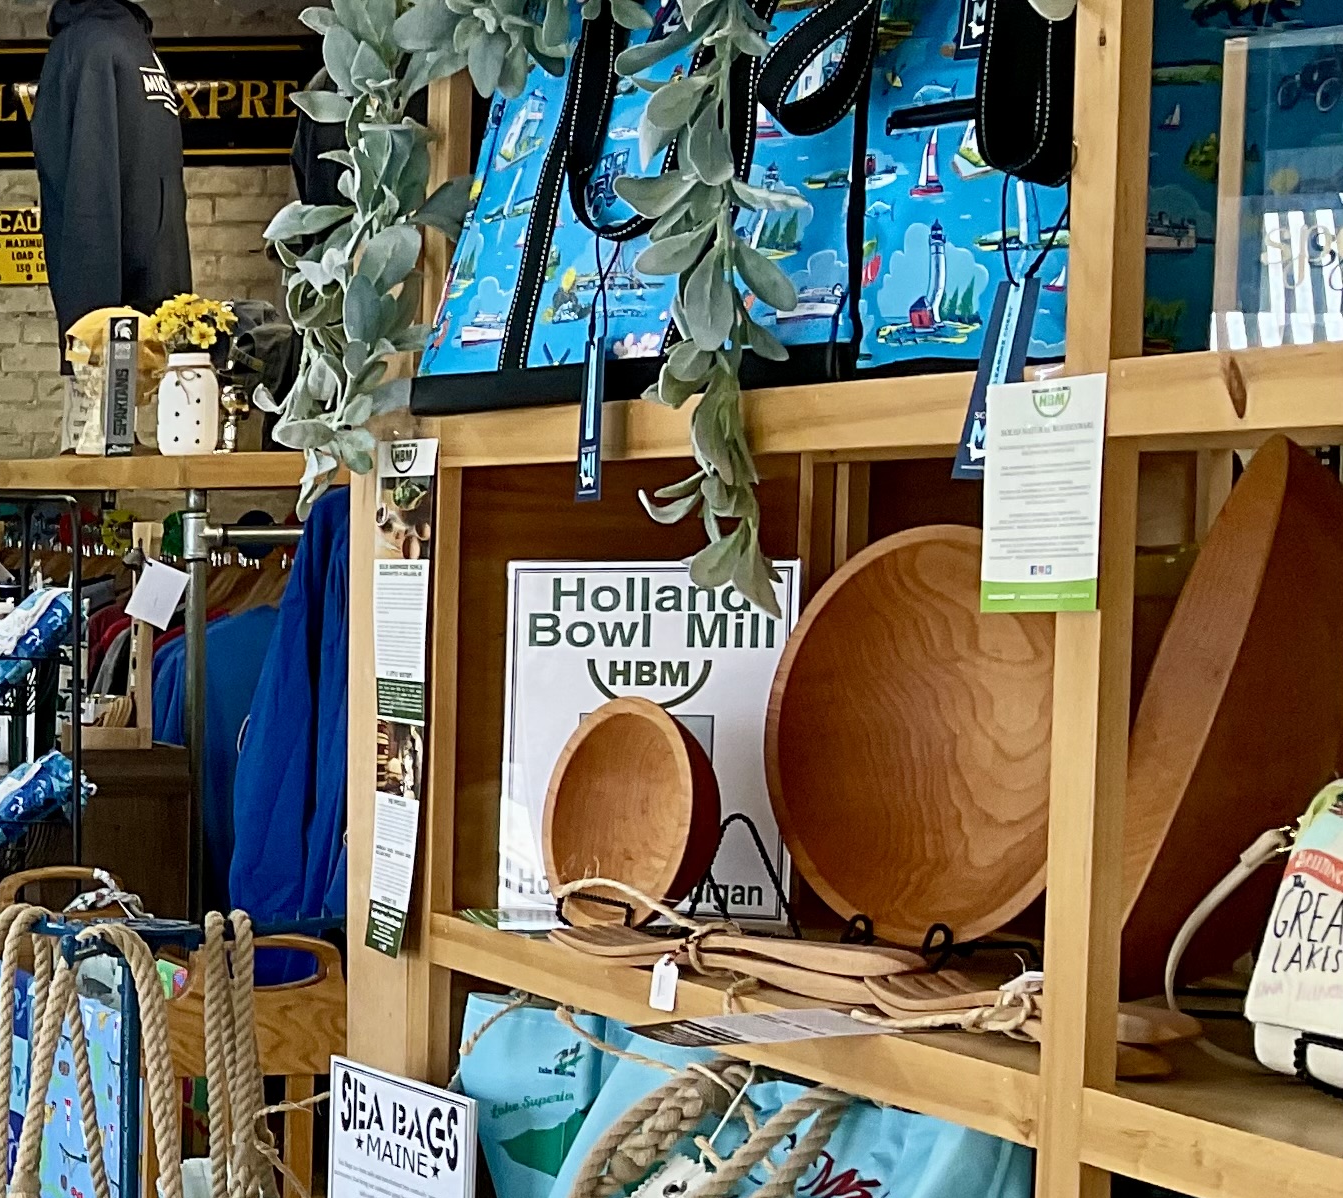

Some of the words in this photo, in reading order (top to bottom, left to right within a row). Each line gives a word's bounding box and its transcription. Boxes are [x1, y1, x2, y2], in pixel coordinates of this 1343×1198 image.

[175, 78, 299, 121] XPRE
[11, 251, 34, 260] LOAD
[16, 263, 31, 272] 150
[113, 368, 130, 437] SPARTANS
[581, 451, 597, 478] MI
[527, 612, 652, 648] Bowl
[686, 612, 776, 649] Mill
[608, 658, 690, 687] HBM
[1273, 889, 1343, 945] GREA
[339, 1070, 385, 1133] SEA
[391, 1100, 459, 1172] BAGS
[365, 1135, 429, 1179] MAINE
